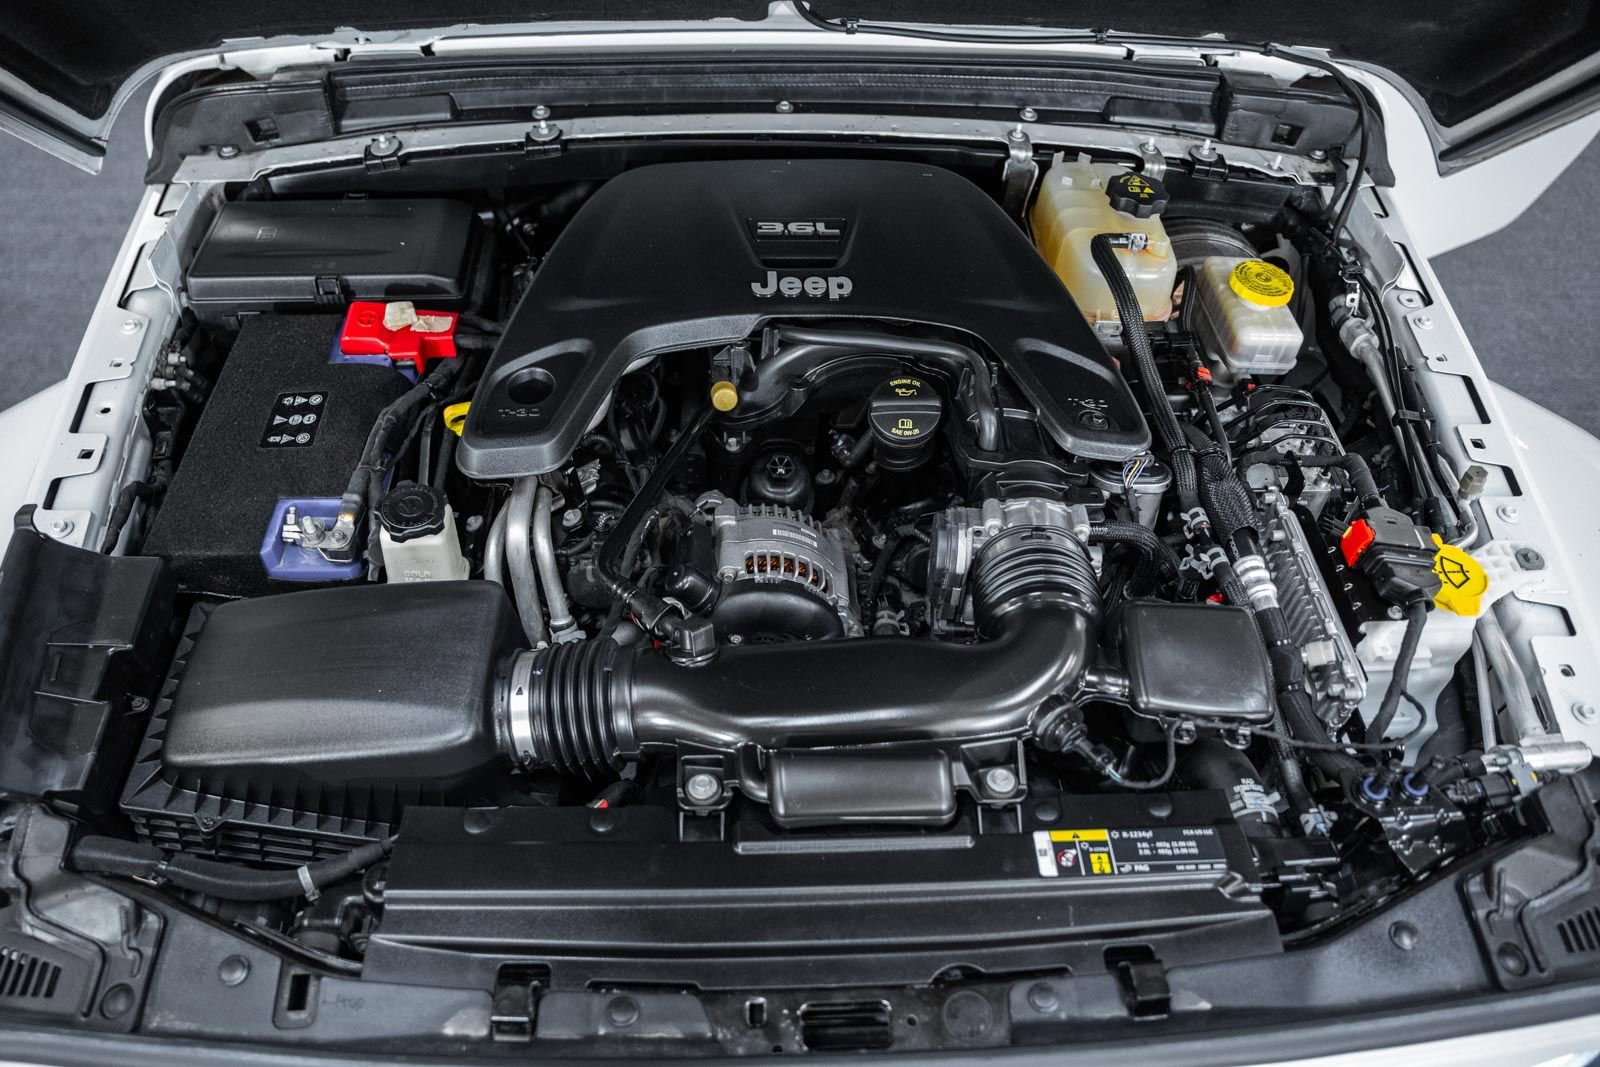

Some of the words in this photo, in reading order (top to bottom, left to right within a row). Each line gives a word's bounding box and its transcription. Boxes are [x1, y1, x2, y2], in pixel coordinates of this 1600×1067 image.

[757, 222, 840, 236] 3.6L
[751, 270, 853, 301] Jeep
[889, 379, 911, 387] ENGINE
[891, 427, 903, 435] SAE
